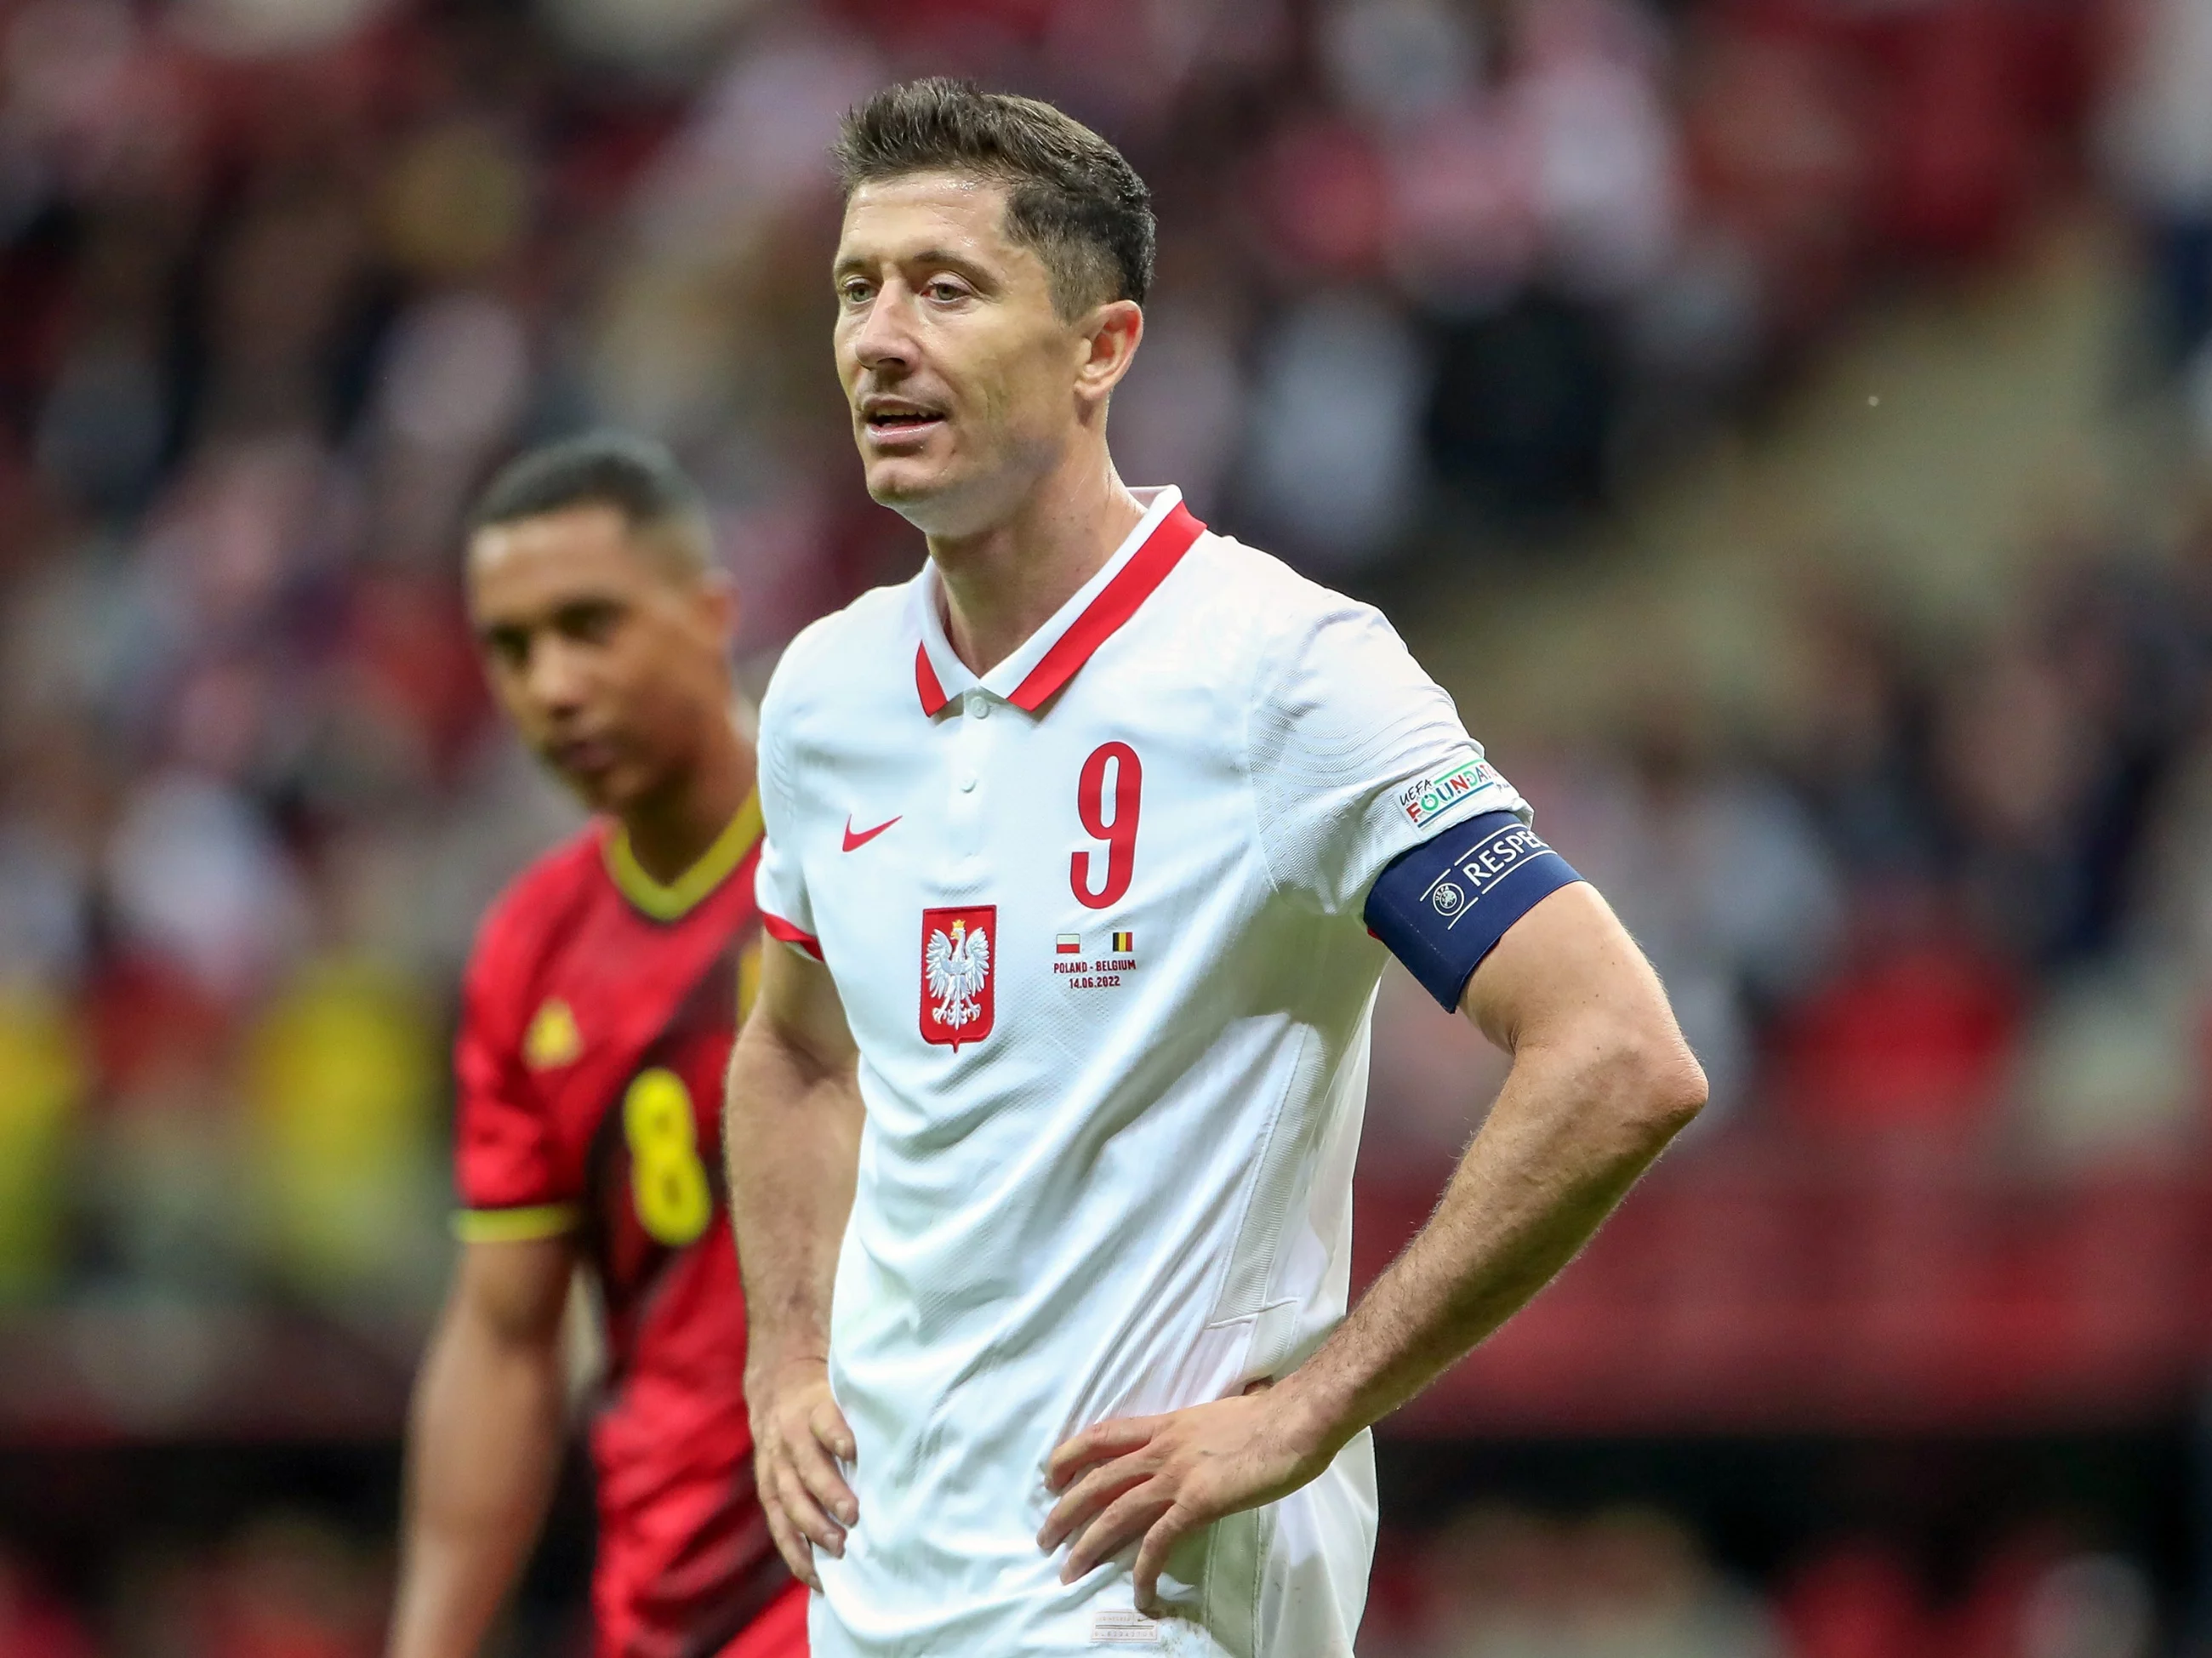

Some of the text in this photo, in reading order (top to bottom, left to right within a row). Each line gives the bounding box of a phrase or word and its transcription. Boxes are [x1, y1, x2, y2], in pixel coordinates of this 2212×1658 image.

[1400, 778, 1432, 806] UEFA
[1070, 741, 1142, 909] 9
[1053, 961, 1088, 974] POLAND
[1096, 960, 1137, 971] BELGIUM
[1069, 976, 1120, 989] 14.06.2022
[624, 1067, 713, 1245] 8
